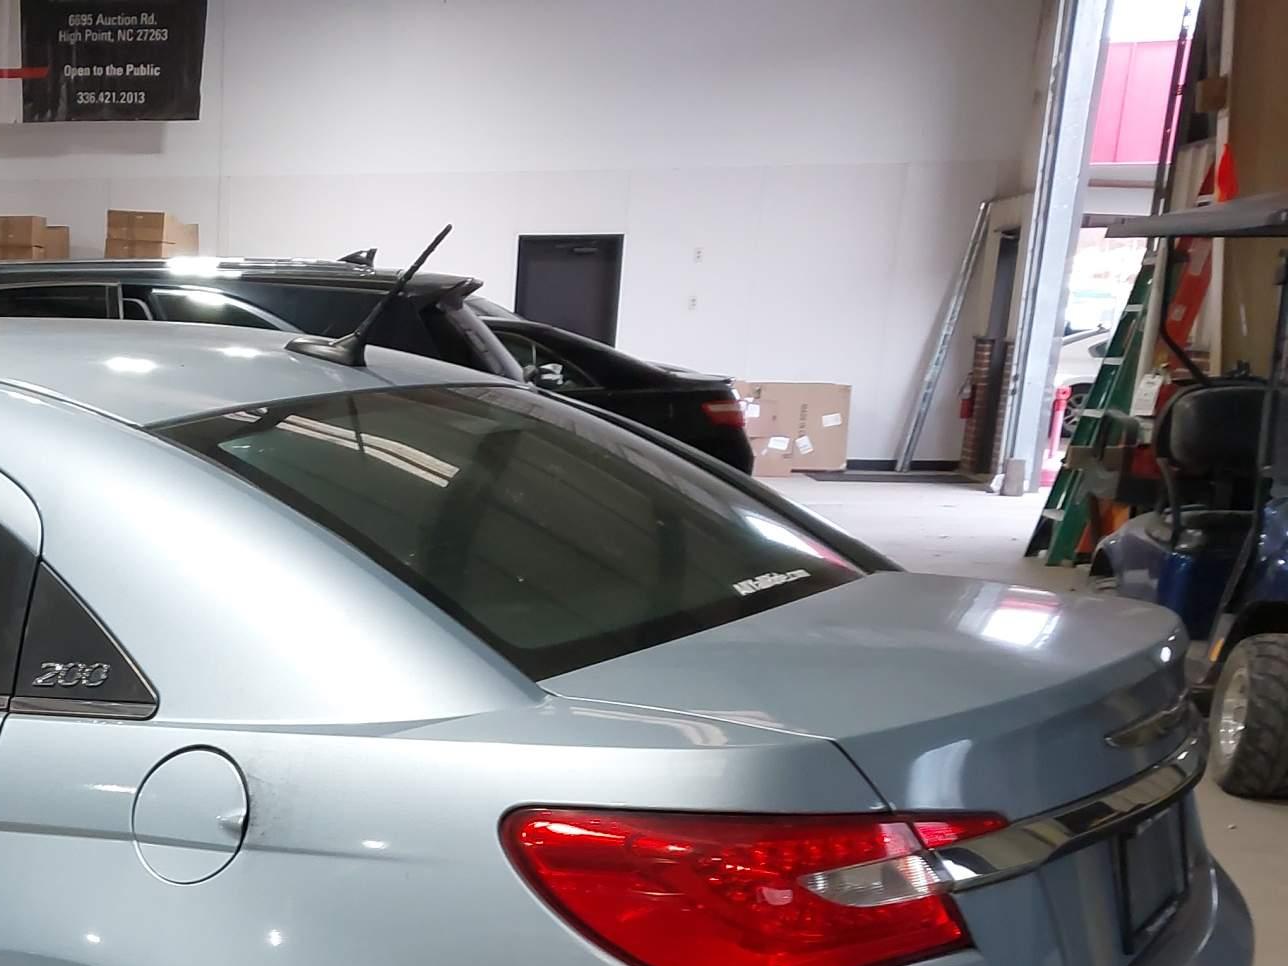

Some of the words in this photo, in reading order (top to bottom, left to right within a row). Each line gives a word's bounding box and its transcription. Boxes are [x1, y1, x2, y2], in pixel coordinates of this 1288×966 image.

[68, 14, 93, 26] 6695
[96, 13, 138, 25] Auction
[140, 13, 158, 25] Rd.
[58, 30, 82, 45] High
[85, 29, 115, 42] Point,
[117, 29, 134, 41] NC
[136, 29, 169, 41] 27263
[64, 64, 91, 80] Open
[93, 65, 104, 76] to
[105, 64, 124, 76] the
[126, 63, 161, 76] Public
[76, 91, 146, 104] 336.421.2013
[32, 662, 110, 686] 200
